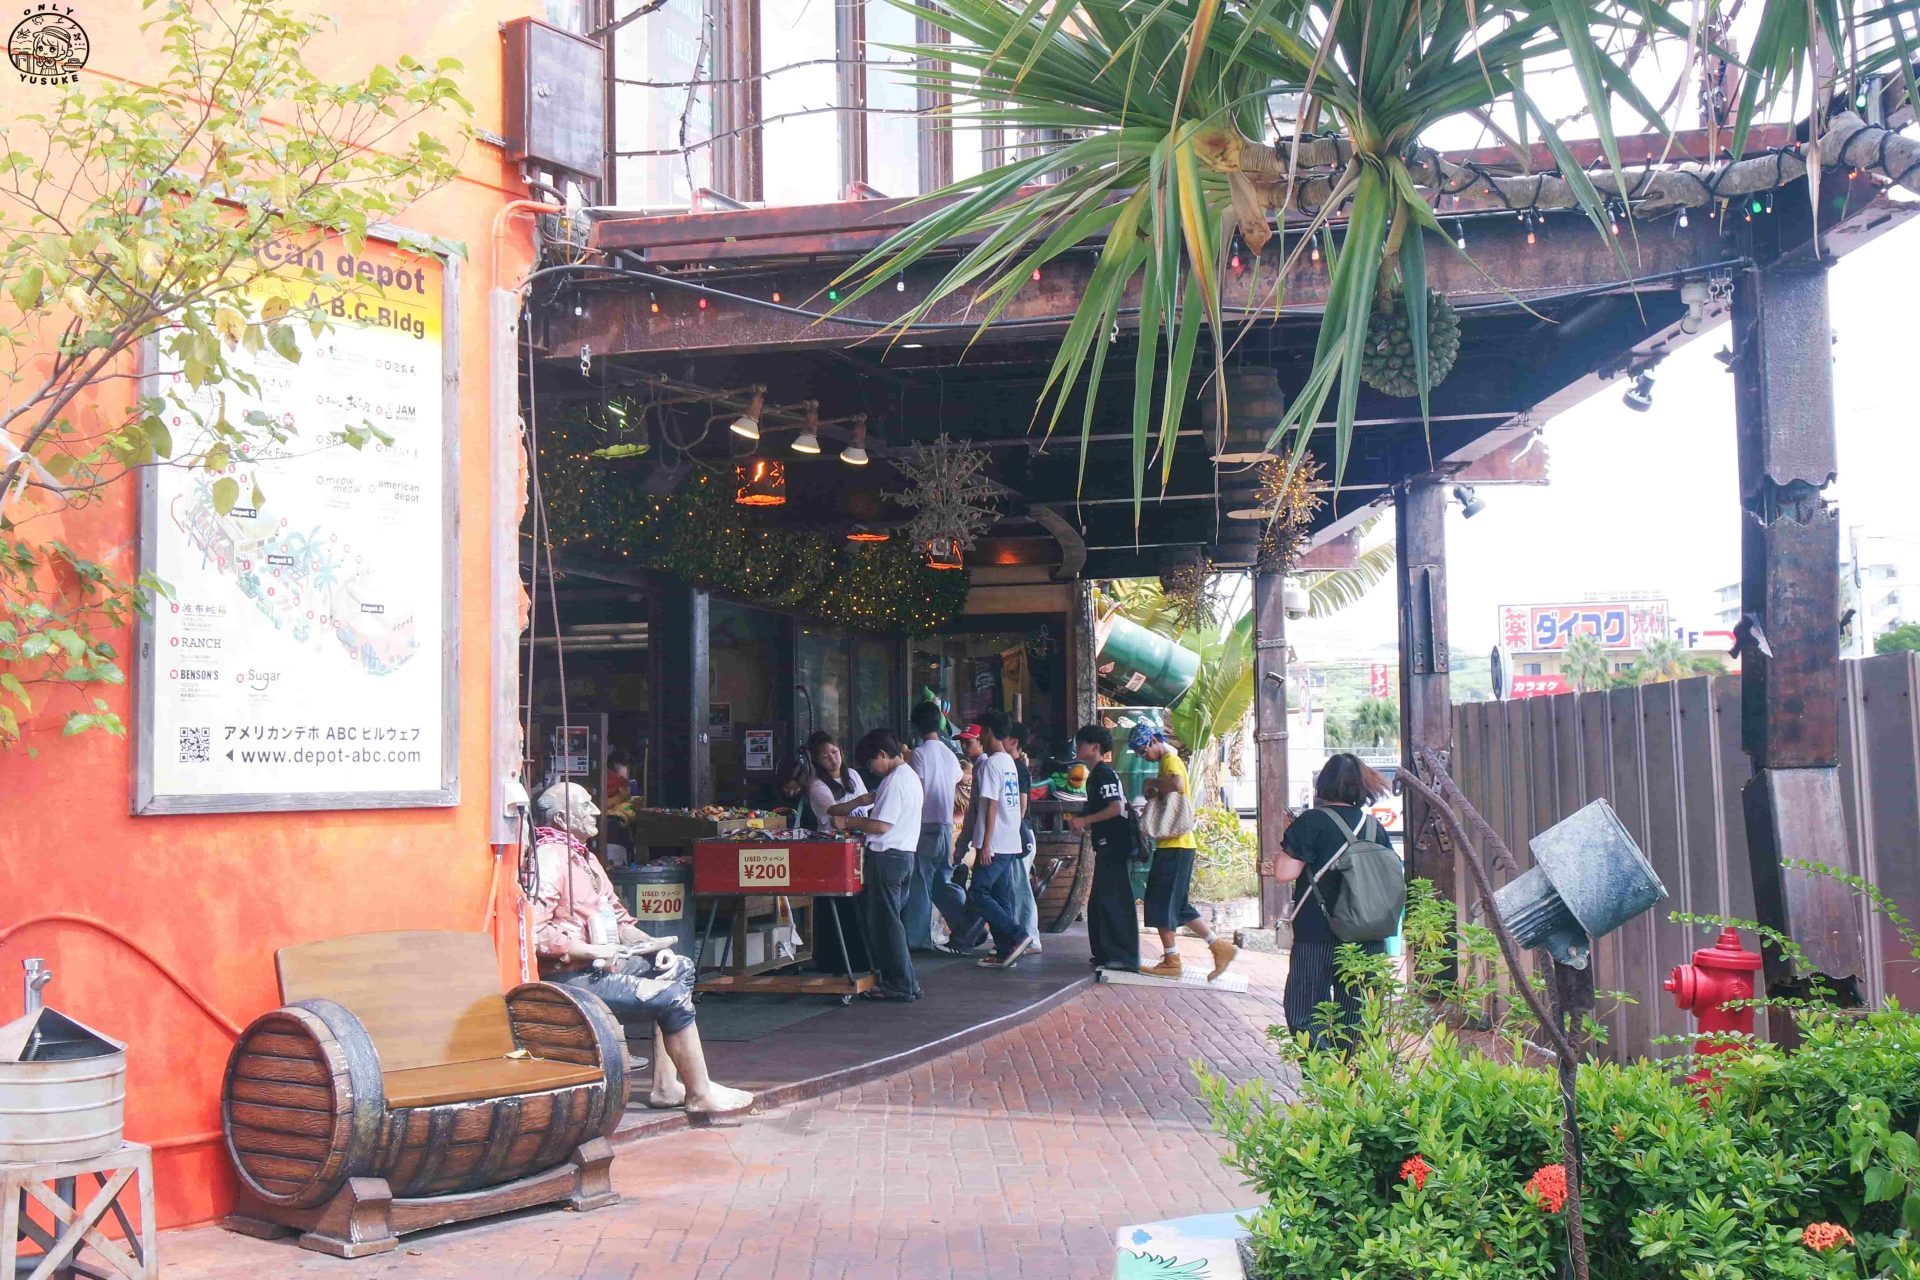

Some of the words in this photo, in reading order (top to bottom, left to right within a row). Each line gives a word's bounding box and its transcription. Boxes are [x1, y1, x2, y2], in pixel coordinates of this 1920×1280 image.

[336, 253, 425, 295] depot
[395, 404, 416, 417] JAM
[325, 477, 354, 486] meow
[378, 480, 420, 492] american
[333, 485, 361, 494] meow
[394, 492, 419, 503] depot
[1505, 613, 1527, 649] 薬
[1536, 611, 1625, 645] ダイコク
[181, 637, 222, 649] RANCH
[180, 669, 219, 681] BENSON'S
[247, 669, 281, 691] Sugar
[1514, 681, 1558, 692] カラオケ
[325, 727, 357, 741] ABC
[241, 747, 421, 766] www.depot-abc.com
[744, 864, 786, 879] ¥200
[641, 898, 682, 914] ¥200
